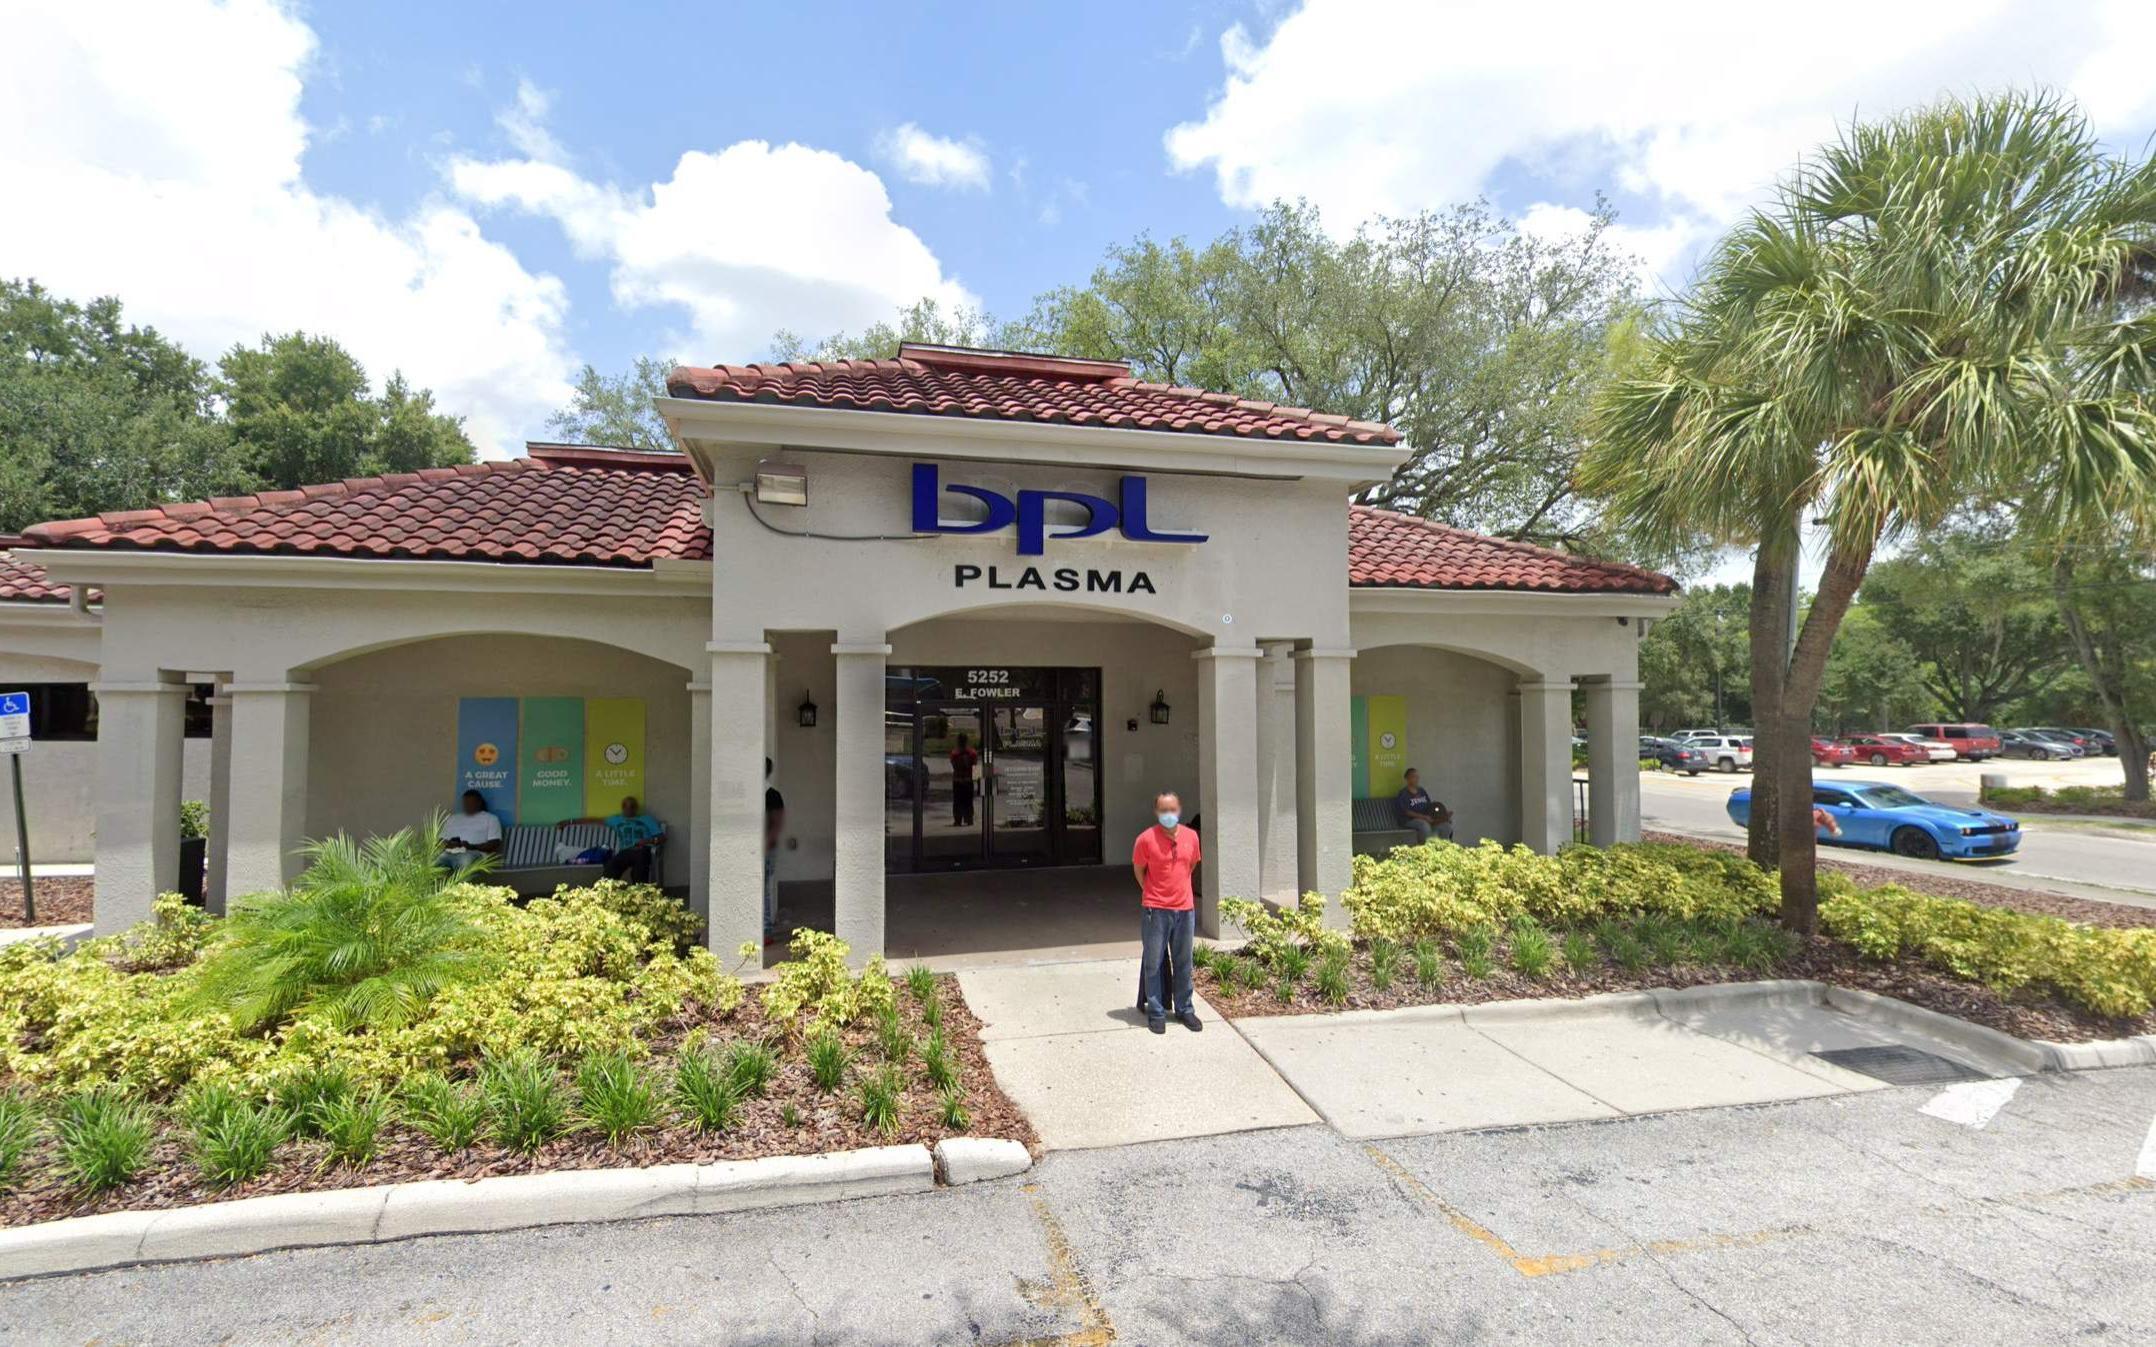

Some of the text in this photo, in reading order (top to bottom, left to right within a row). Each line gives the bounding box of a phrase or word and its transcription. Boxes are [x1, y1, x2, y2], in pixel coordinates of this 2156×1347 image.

[912, 463, 1209, 556] bpl
[954, 564, 1157, 595] PLASMA
[967, 670, 1009, 684] 5252
[971, 688, 1020, 698] FOWLER
[465, 771, 509, 779] A GREAT
[537, 770, 568, 778] GOOD
[532, 779, 572, 787] MONEY.
